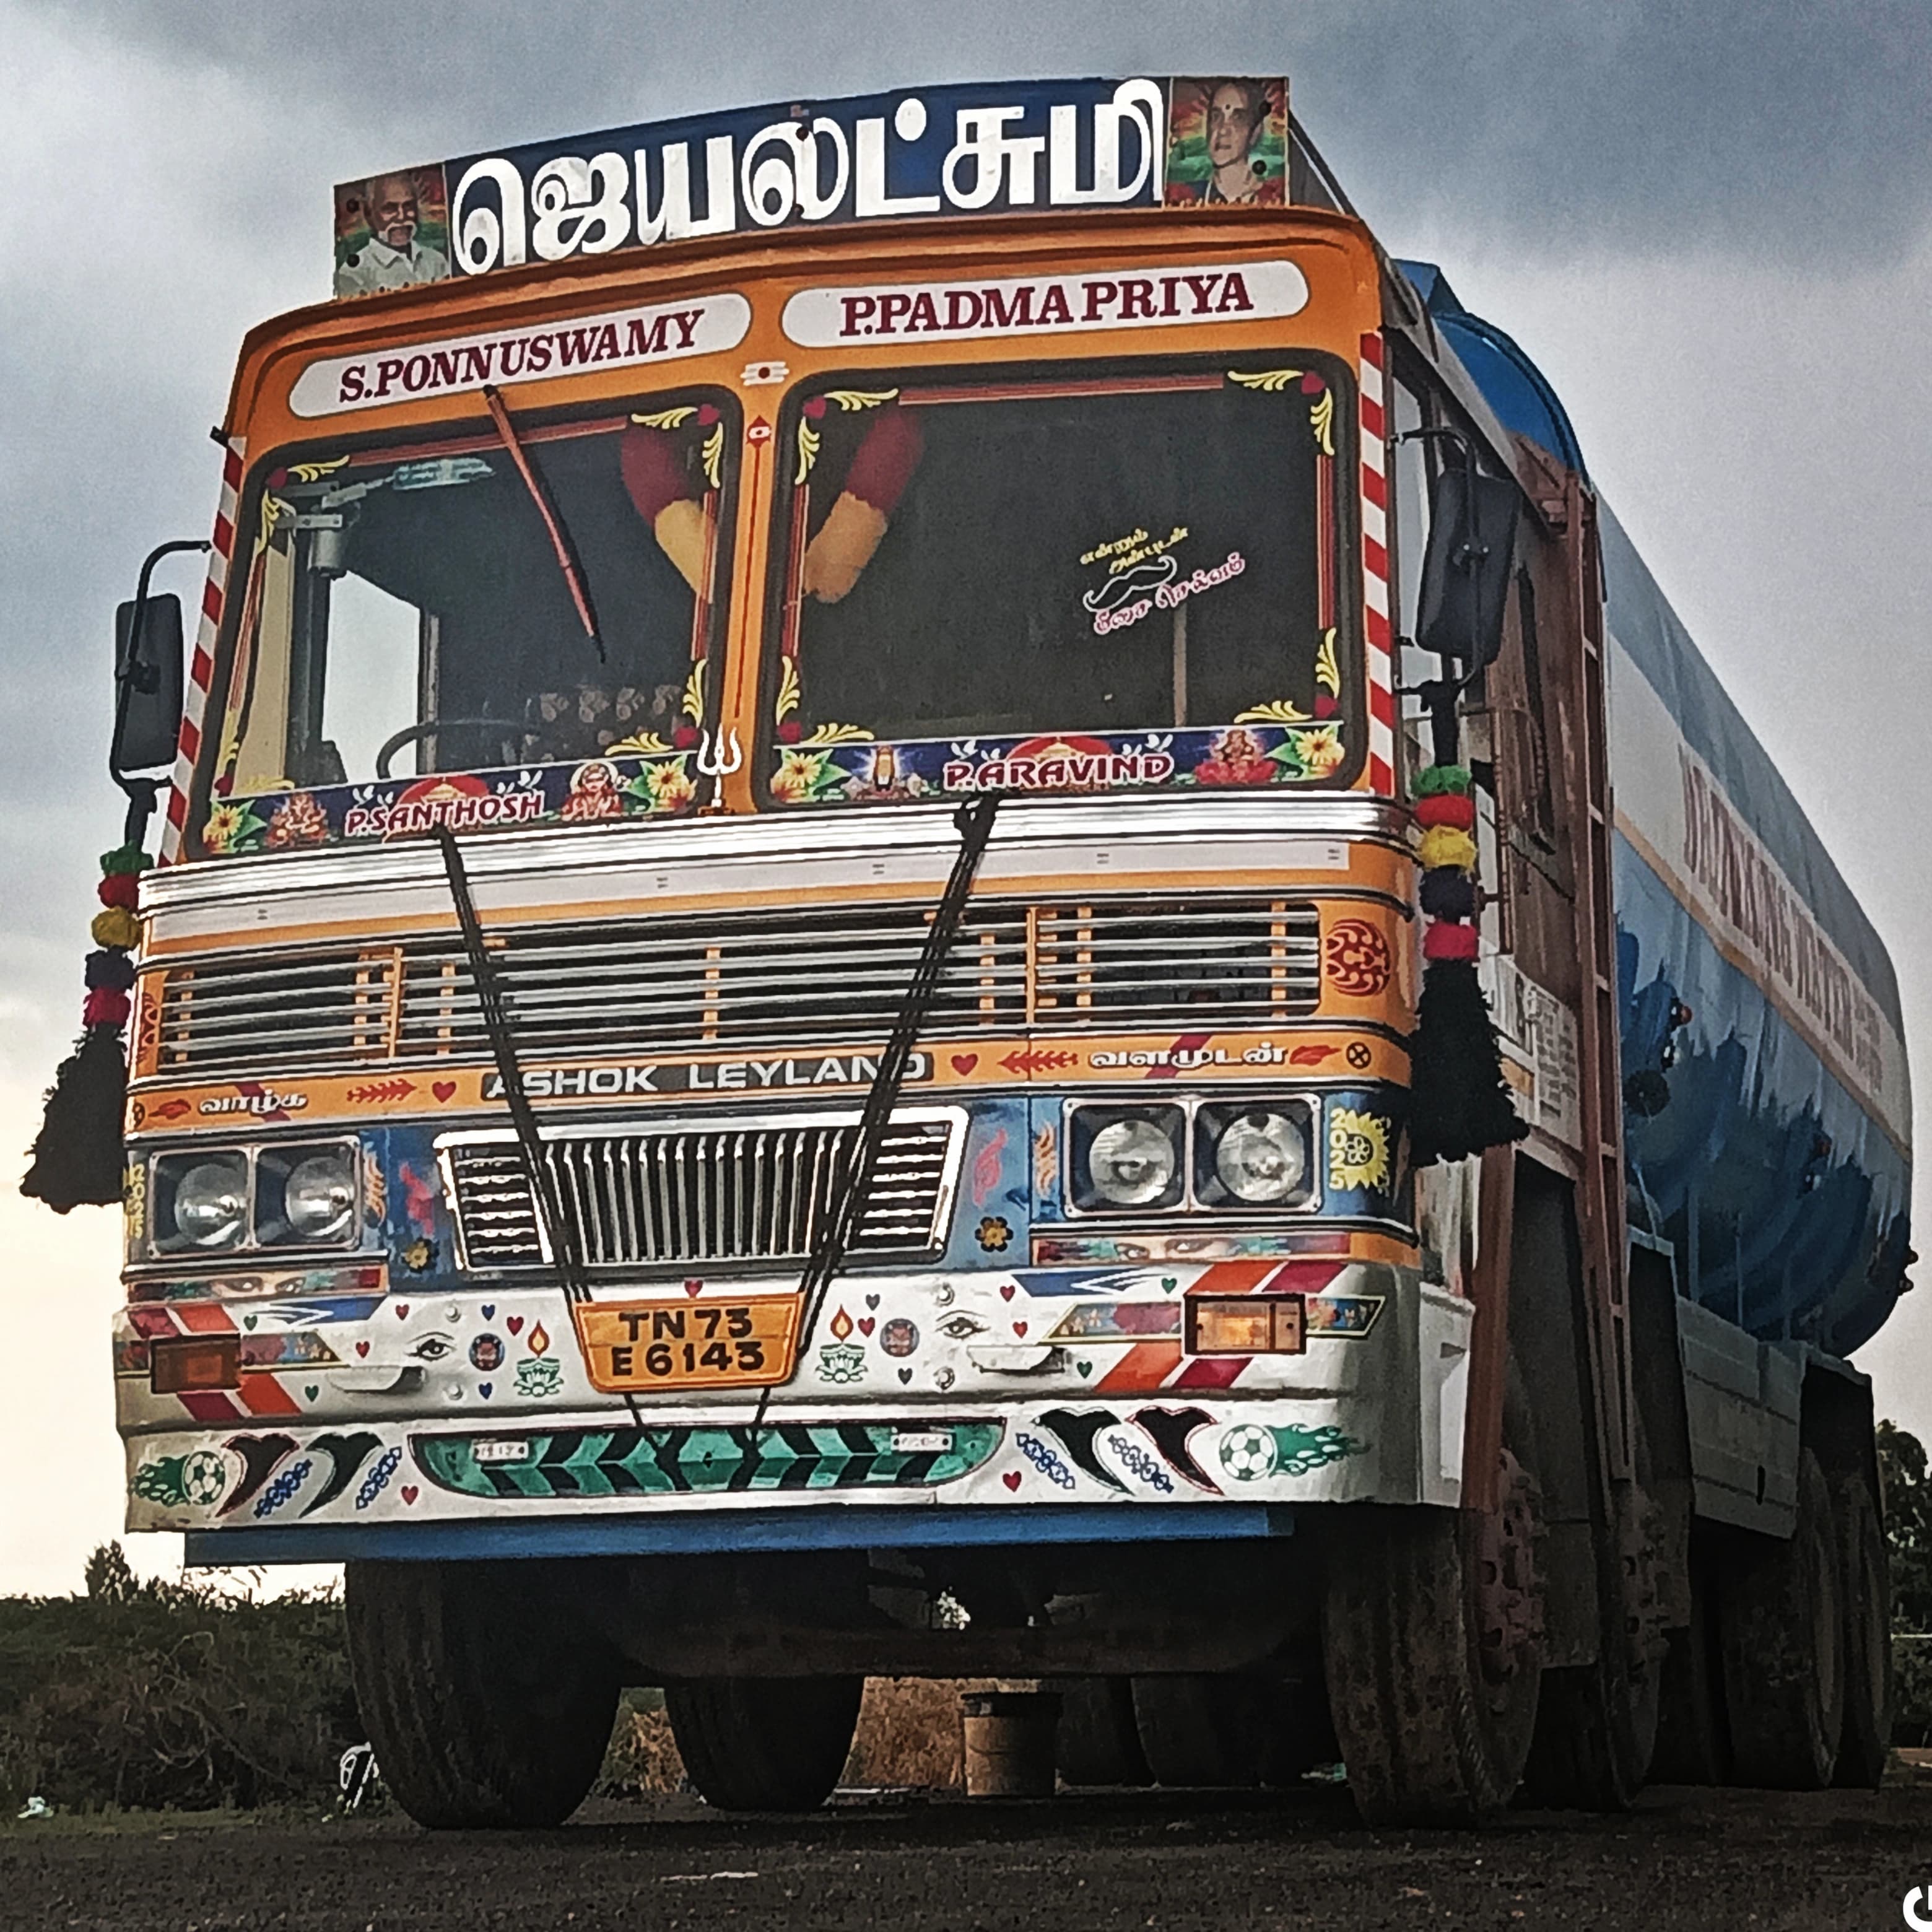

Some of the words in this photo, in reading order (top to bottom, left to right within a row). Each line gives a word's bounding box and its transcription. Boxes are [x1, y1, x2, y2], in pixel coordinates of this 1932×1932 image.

[452, 78, 1165, 275] ஜெயலட்சுமி
[339, 309, 705, 402] S.PONNUSWAMY
[943, 751, 1175, 790] P.ARAVIND
[345, 790, 545, 836] P.SANTHOSH
[689, 1053, 926, 1089] LEYLAND
[1090, 1042, 1286, 1068] வளமுடன்
[199, 1089, 307, 1113] வாழ்க
[619, 1310, 685, 1342] TN
[694, 1307, 752, 1339] 73
